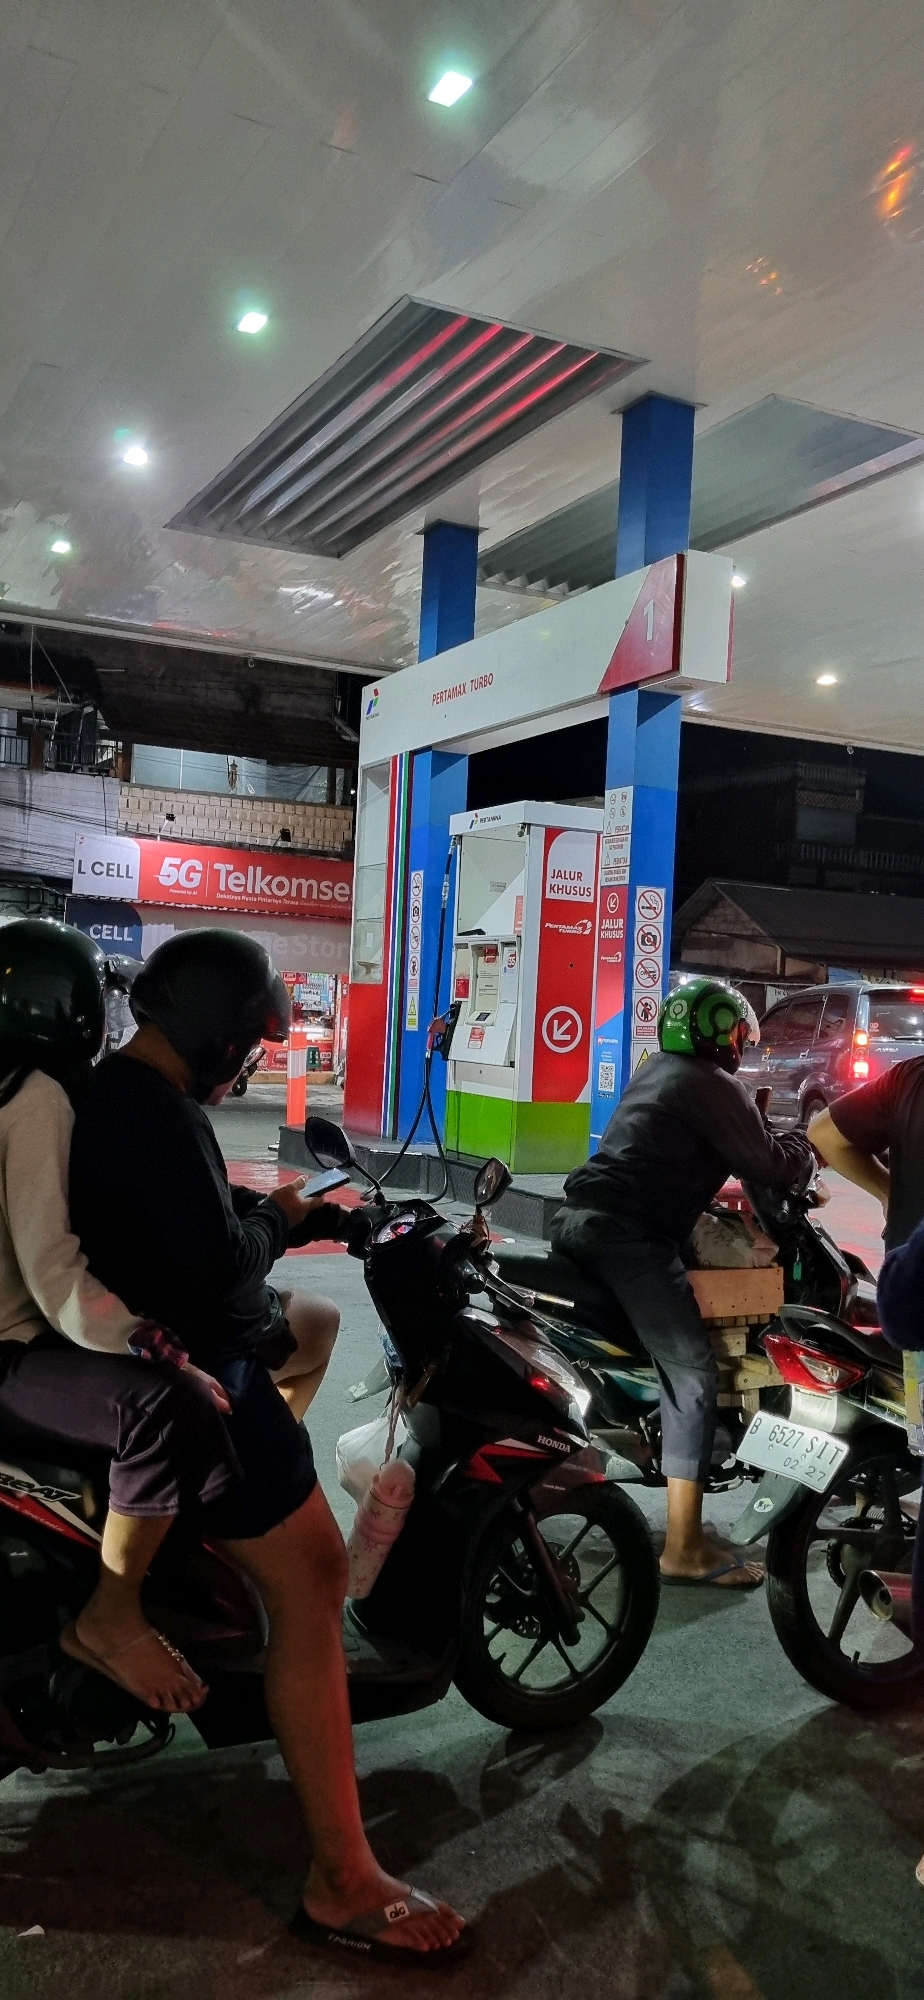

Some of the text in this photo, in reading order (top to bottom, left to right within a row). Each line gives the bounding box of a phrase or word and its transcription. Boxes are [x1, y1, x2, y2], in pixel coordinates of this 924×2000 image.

[643, 599, 654, 641] 1
[431, 672, 494, 706] PERTAMAX TURBO
[480, 815, 502, 823] PERTAMINA
[77, 859, 134, 879] L CELL
[551, 869, 583, 881] JALUR
[156, 856, 352, 903] 5G Telkomse
[549, 884, 592, 897] KHUSUS
[601, 919, 624, 929] JALUR
[90, 923, 133, 941] CELL
[291, 934, 349, 959] Stor
[601, 930, 624, 938] KHUSUS
[537, 1435, 570, 1453] HONDA
[749, 1417, 843, 1465] B 6527 SIT
[328, 1933, 371, 1950] FASHION
